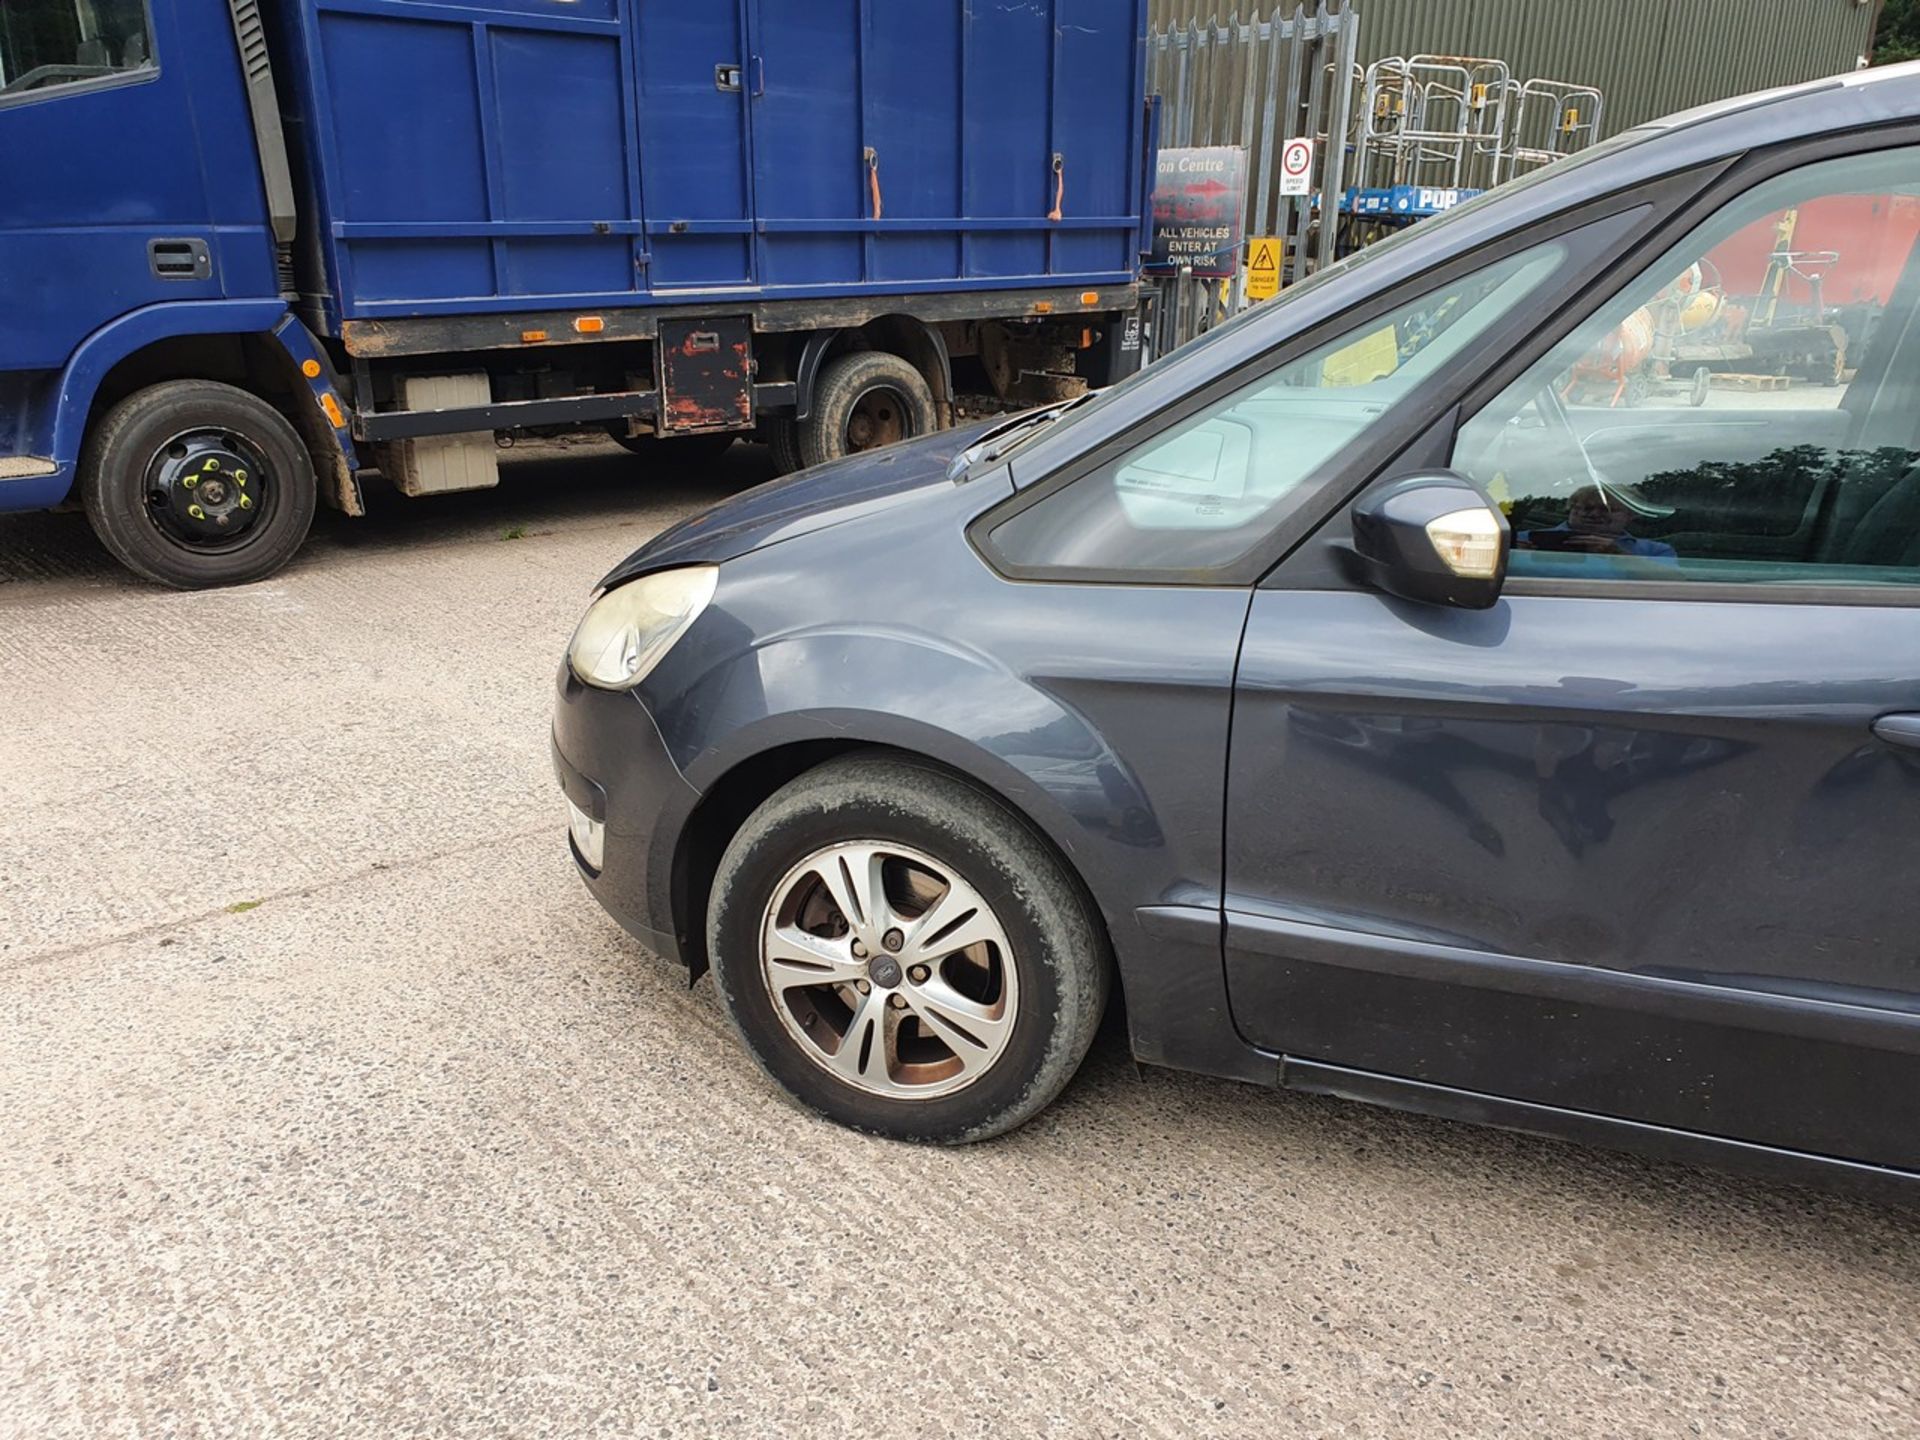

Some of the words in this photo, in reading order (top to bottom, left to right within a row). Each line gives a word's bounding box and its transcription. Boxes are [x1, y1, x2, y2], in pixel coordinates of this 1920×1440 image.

[1293, 149, 1301, 161] 5
[1179, 157, 1224, 172] Centre
[1159, 227, 1178, 238] ALL
[1180, 227, 1230, 239] VEHICLES
[1168, 241, 1202, 252] ENTER
[1203, 241, 1217, 252] AT
[1167, 255, 1192, 266] OWN
[1193, 255, 1217, 267] RISK
